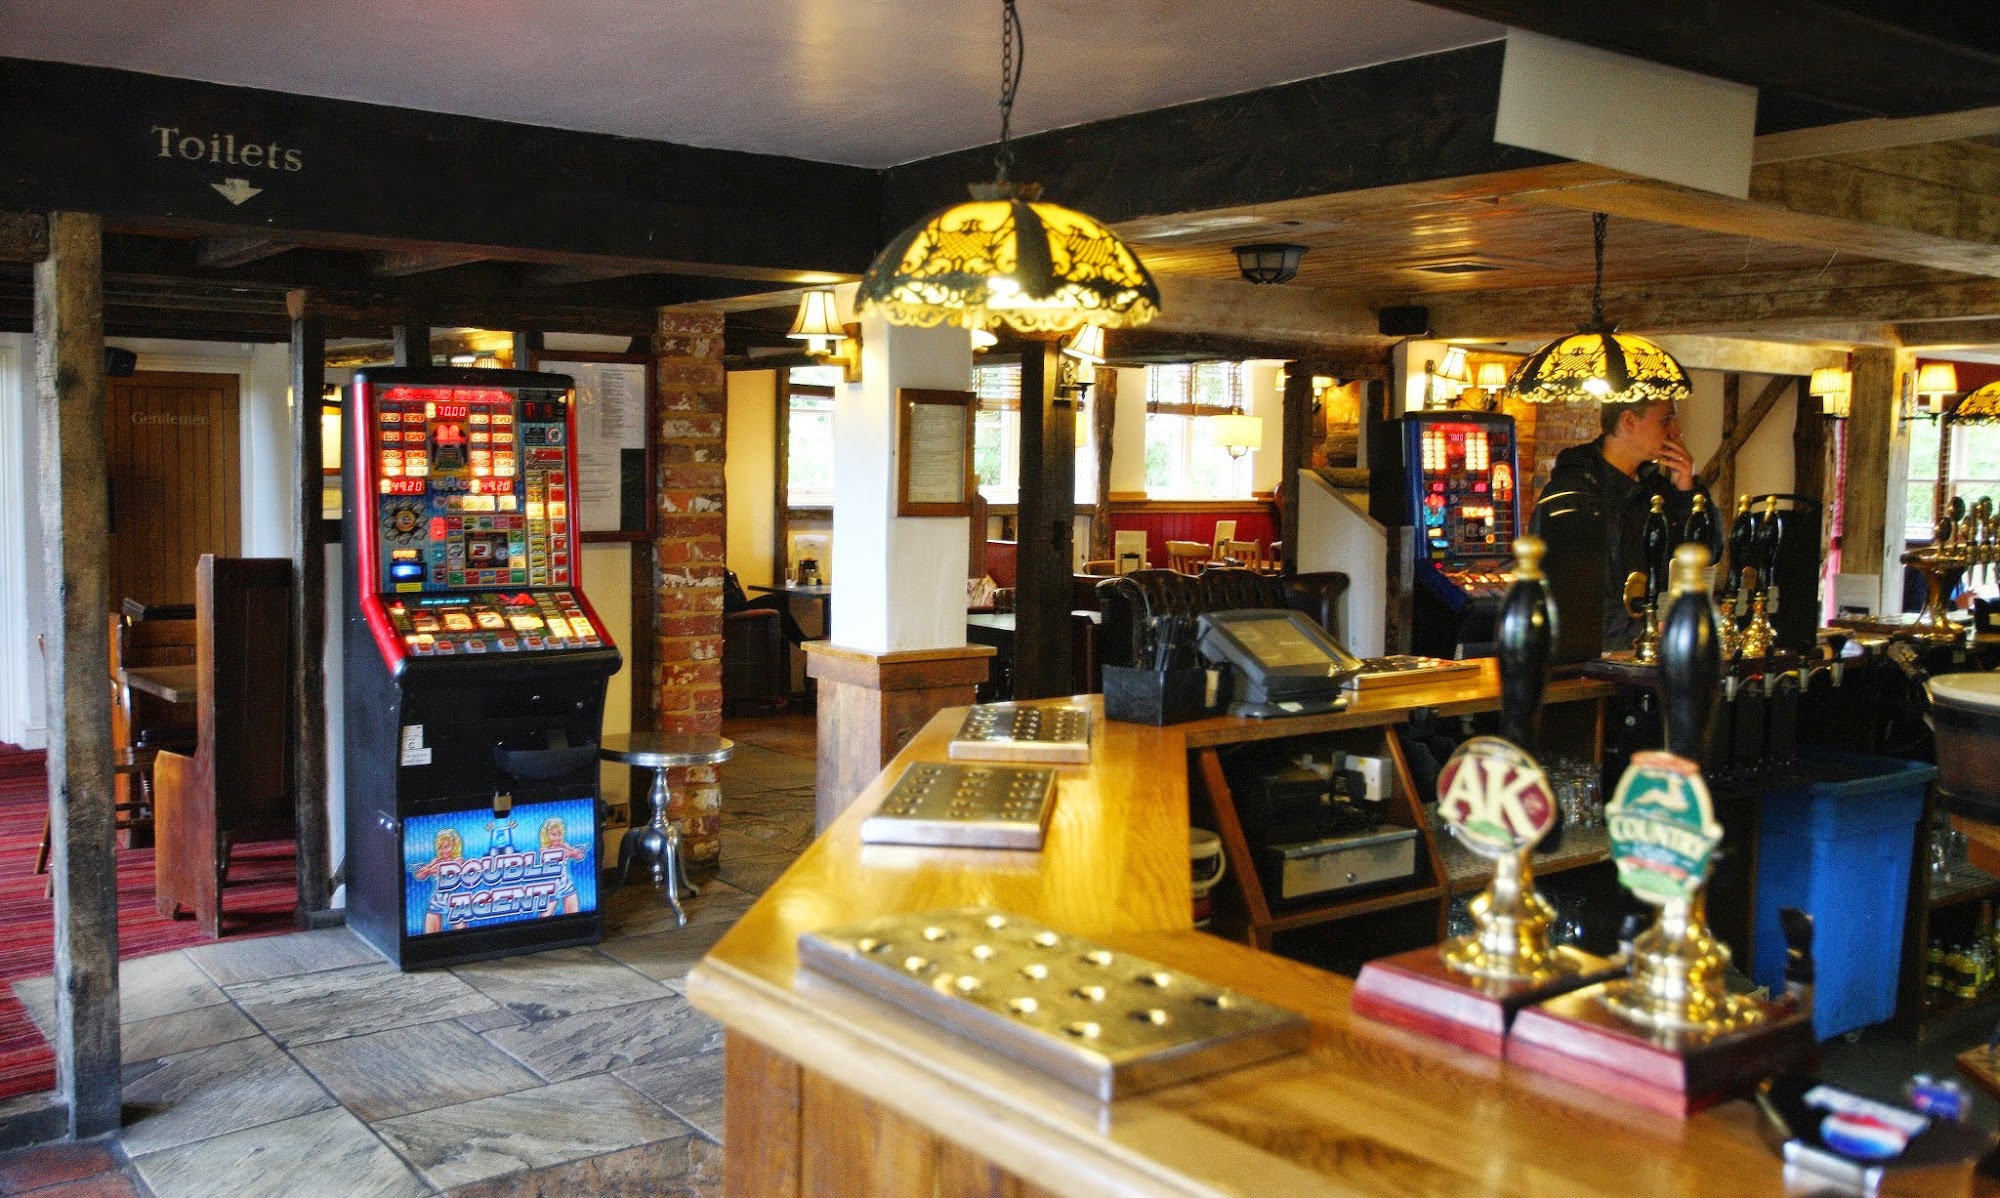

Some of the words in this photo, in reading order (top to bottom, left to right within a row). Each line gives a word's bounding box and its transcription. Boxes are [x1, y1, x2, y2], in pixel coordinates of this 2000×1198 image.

[150, 125, 303, 172] Toilets
[131, 411, 210, 425] Gentlemen
[1438, 753, 1544, 845] AK
[437, 850, 565, 891] DOUBLE
[448, 882, 557, 923] AGENT
